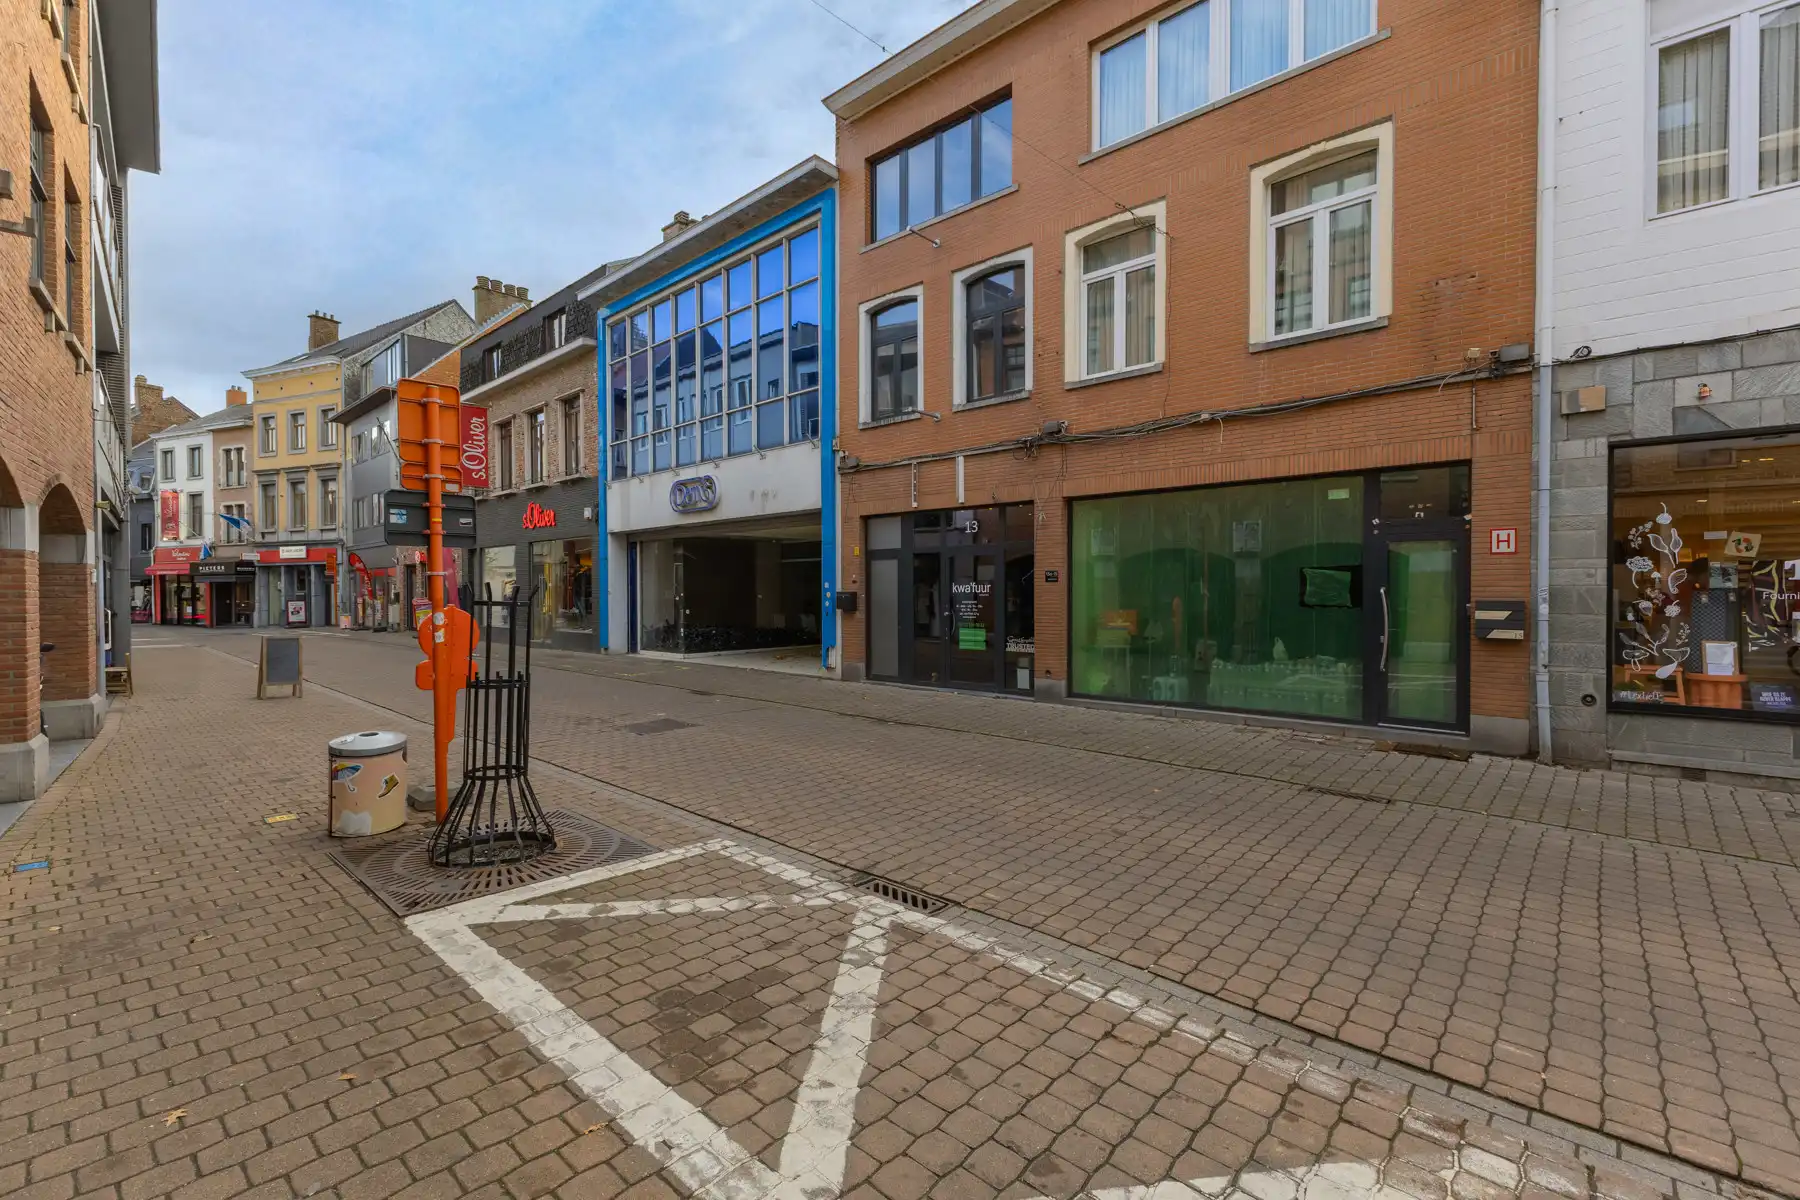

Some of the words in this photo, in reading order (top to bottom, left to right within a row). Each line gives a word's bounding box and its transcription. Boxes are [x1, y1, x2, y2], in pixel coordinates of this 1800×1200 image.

[461, 416, 487, 480] s.Oliver
[522, 501, 556, 529] s.Oliver
[965, 520, 979, 533] 13
[1496, 533, 1510, 550] H
